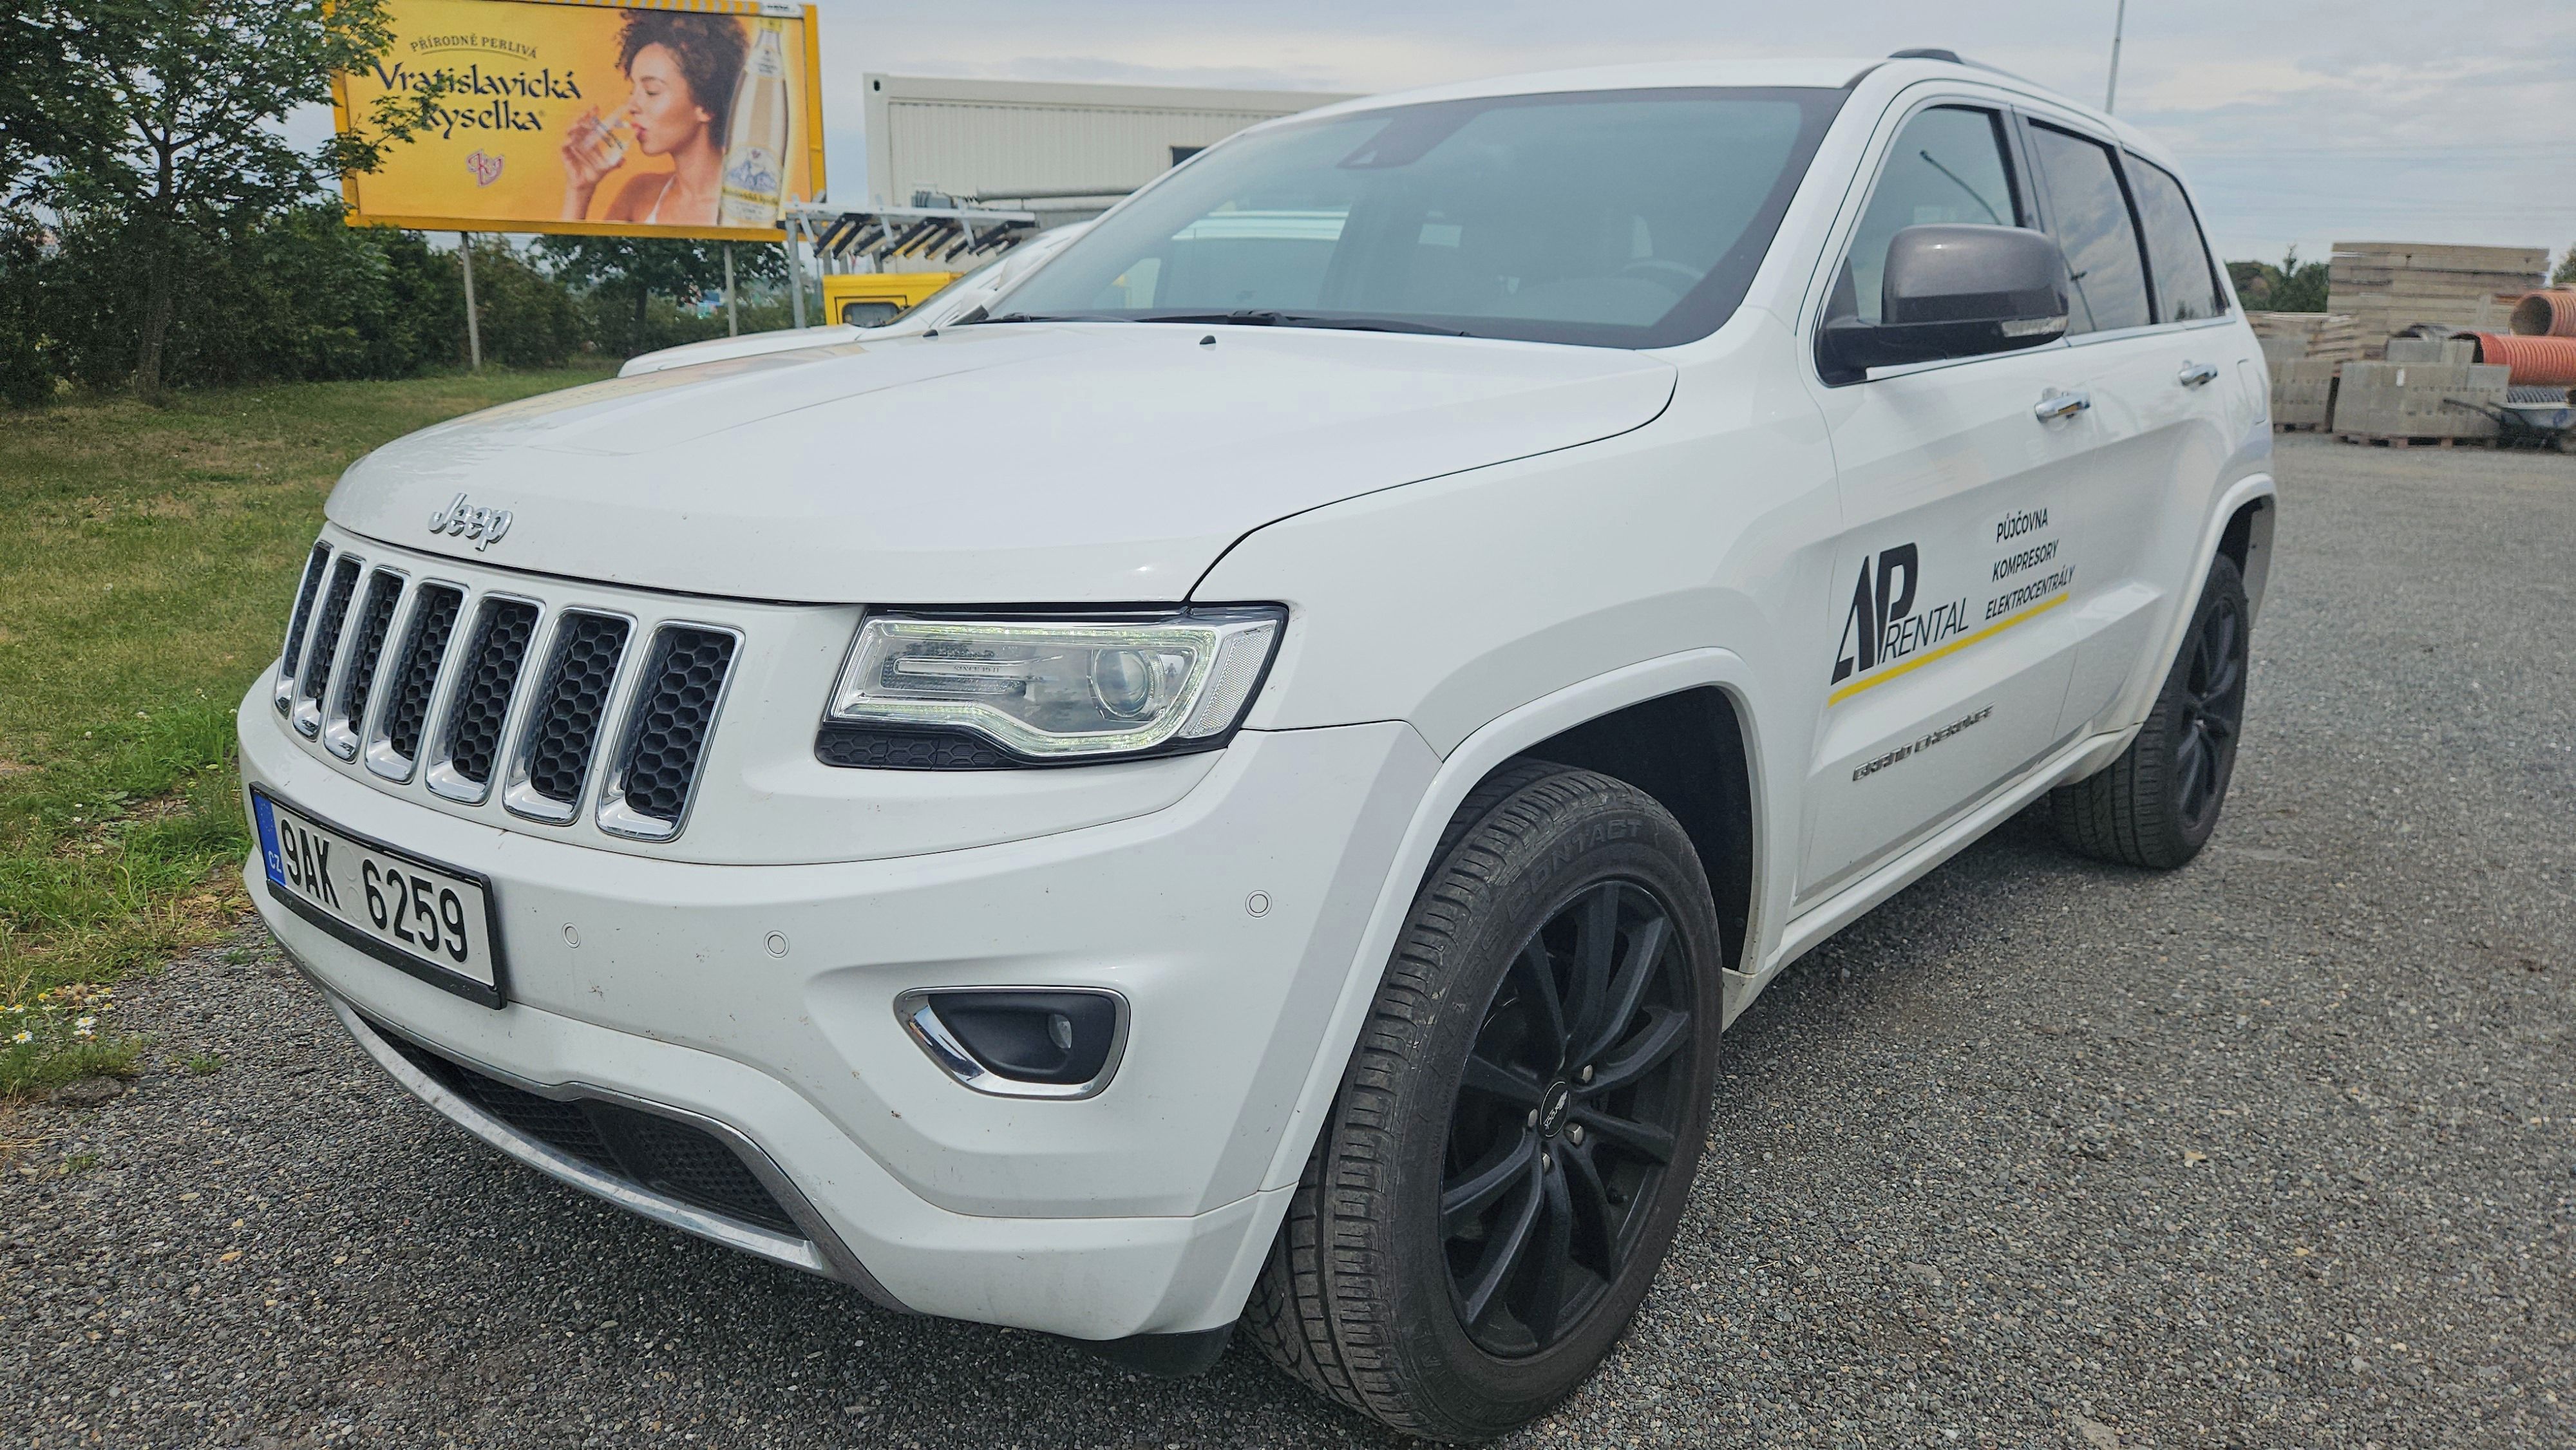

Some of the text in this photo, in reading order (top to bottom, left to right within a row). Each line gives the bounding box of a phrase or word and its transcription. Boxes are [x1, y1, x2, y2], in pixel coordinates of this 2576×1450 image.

[481, 36, 537, 59] PERLIVÁ
[374, 62, 582, 99] Vratislavická
[428, 492, 513, 552] Jeep
[1996, 507, 2049, 543] PŮJČOVNA
[1992, 538, 2060, 583] KOMPRESORY
[1831, 542, 1918, 686] AP
[1985, 564, 2076, 621] ELEKTROCENTRÁLY
[1880, 598, 1969, 664] RENTAL
[267, 849, 283, 873] CZ
[281, 819, 468, 963] 9AK 6259
